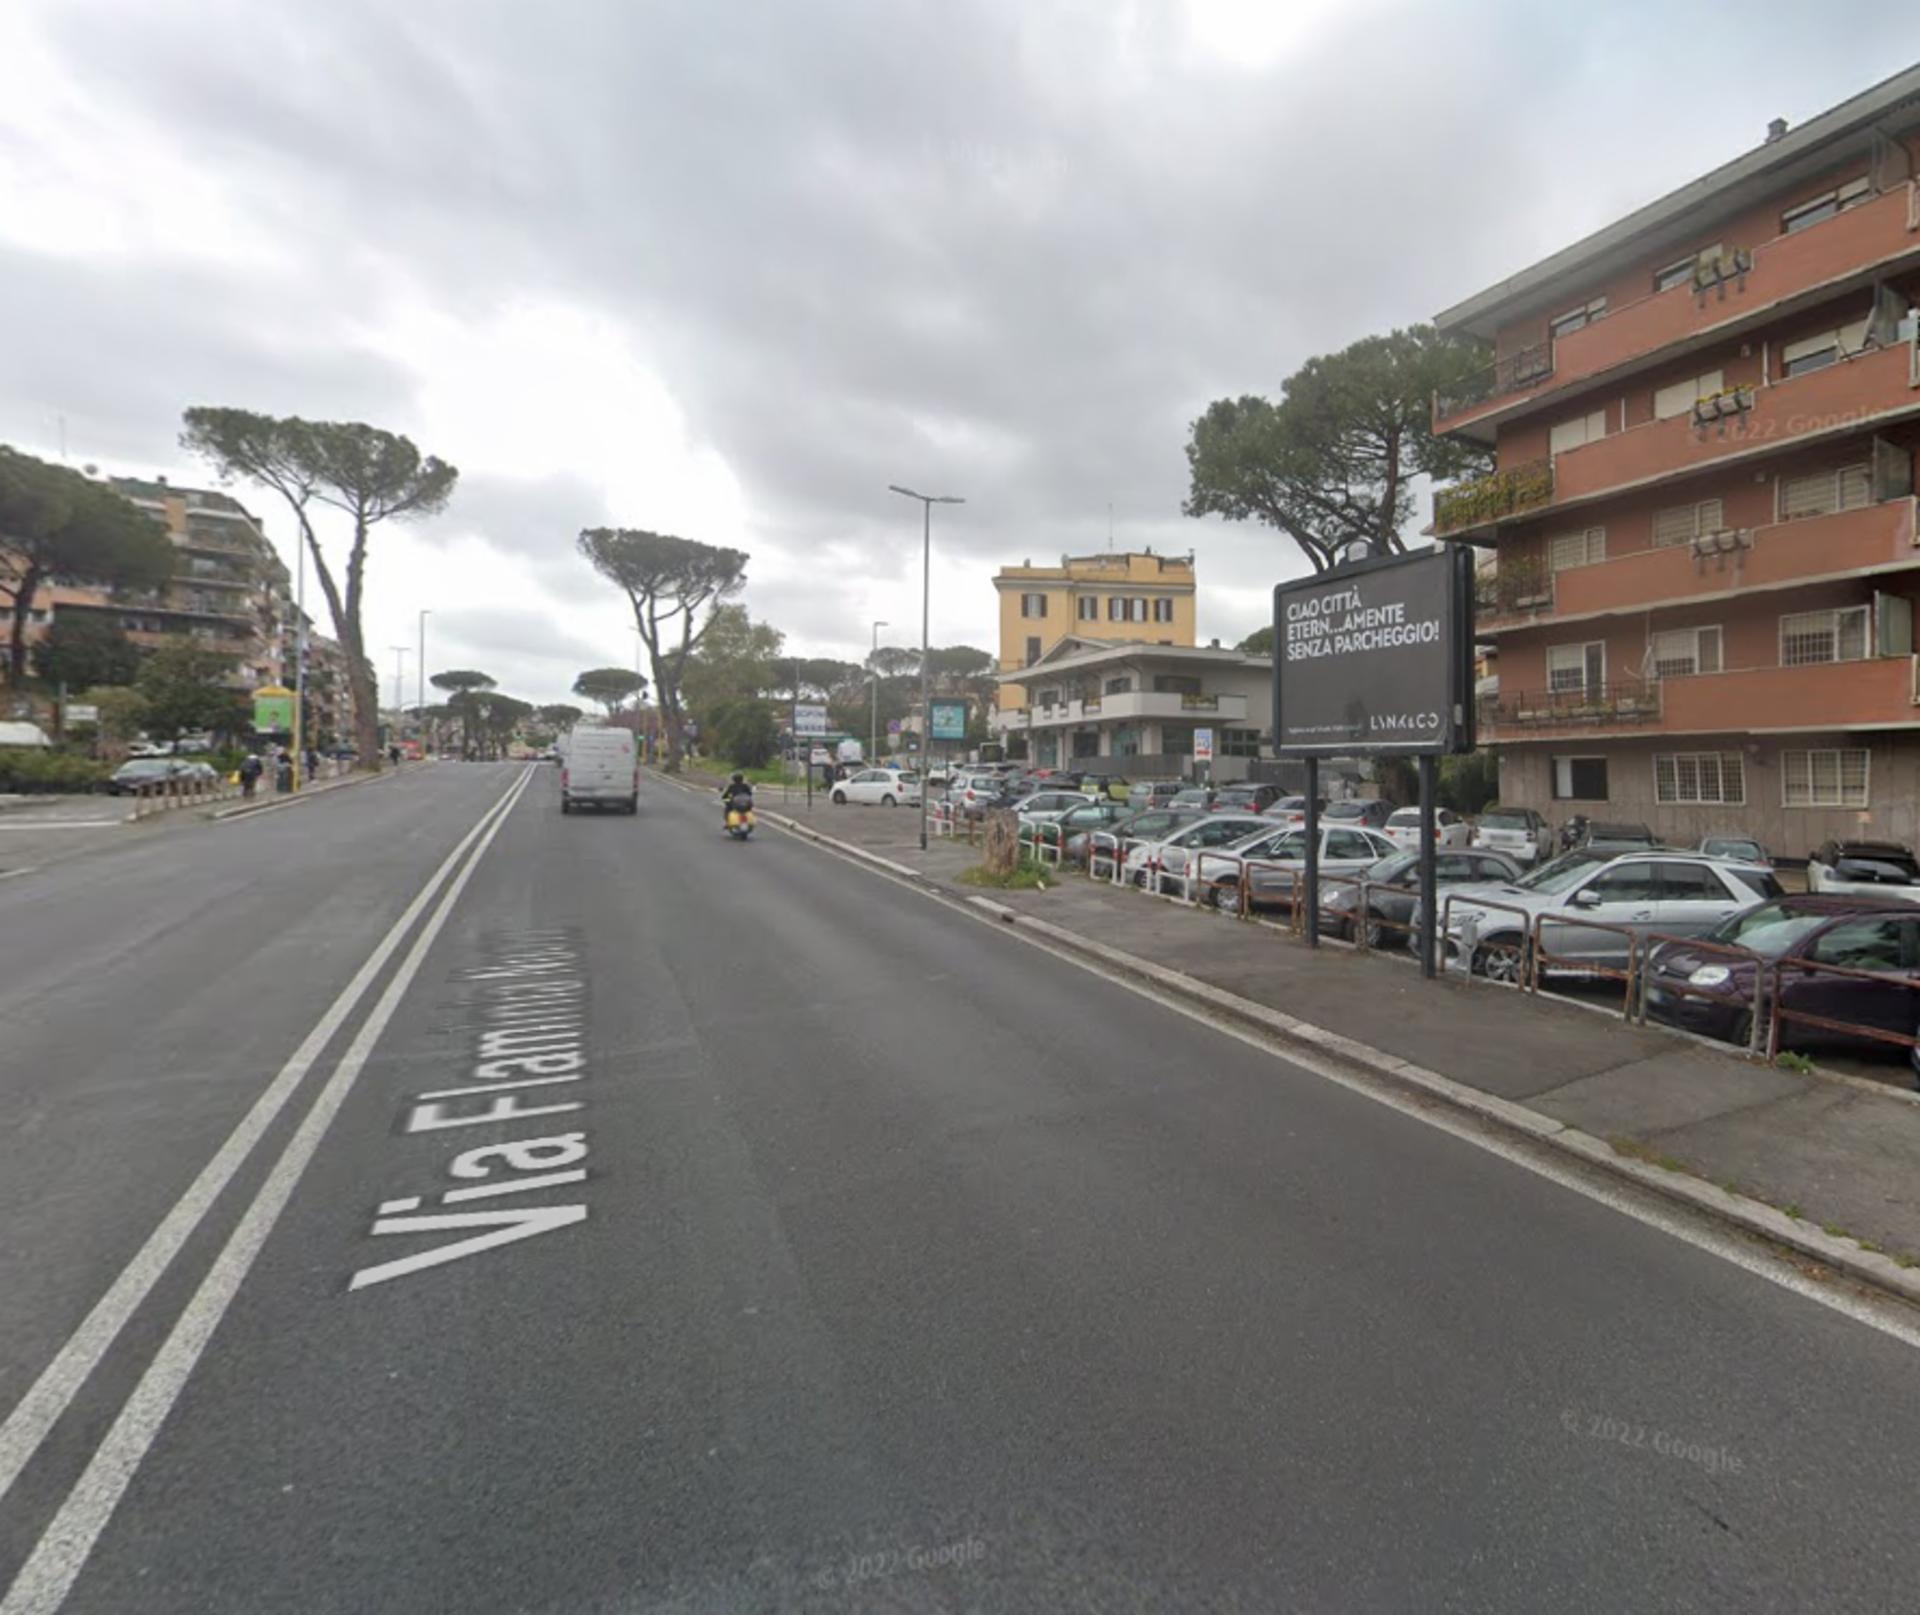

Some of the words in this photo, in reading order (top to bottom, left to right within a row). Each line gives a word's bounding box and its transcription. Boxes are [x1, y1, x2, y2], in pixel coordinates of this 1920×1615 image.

[1287, 598, 1320, 621] CIAO
[1321, 584, 1362, 614] CITTÀ
[1287, 602, 1405, 641] ETERN...AMENTE
[1287, 636, 1333, 661] SENZA
[1334, 619, 1440, 654] PARCHEGGIO!
